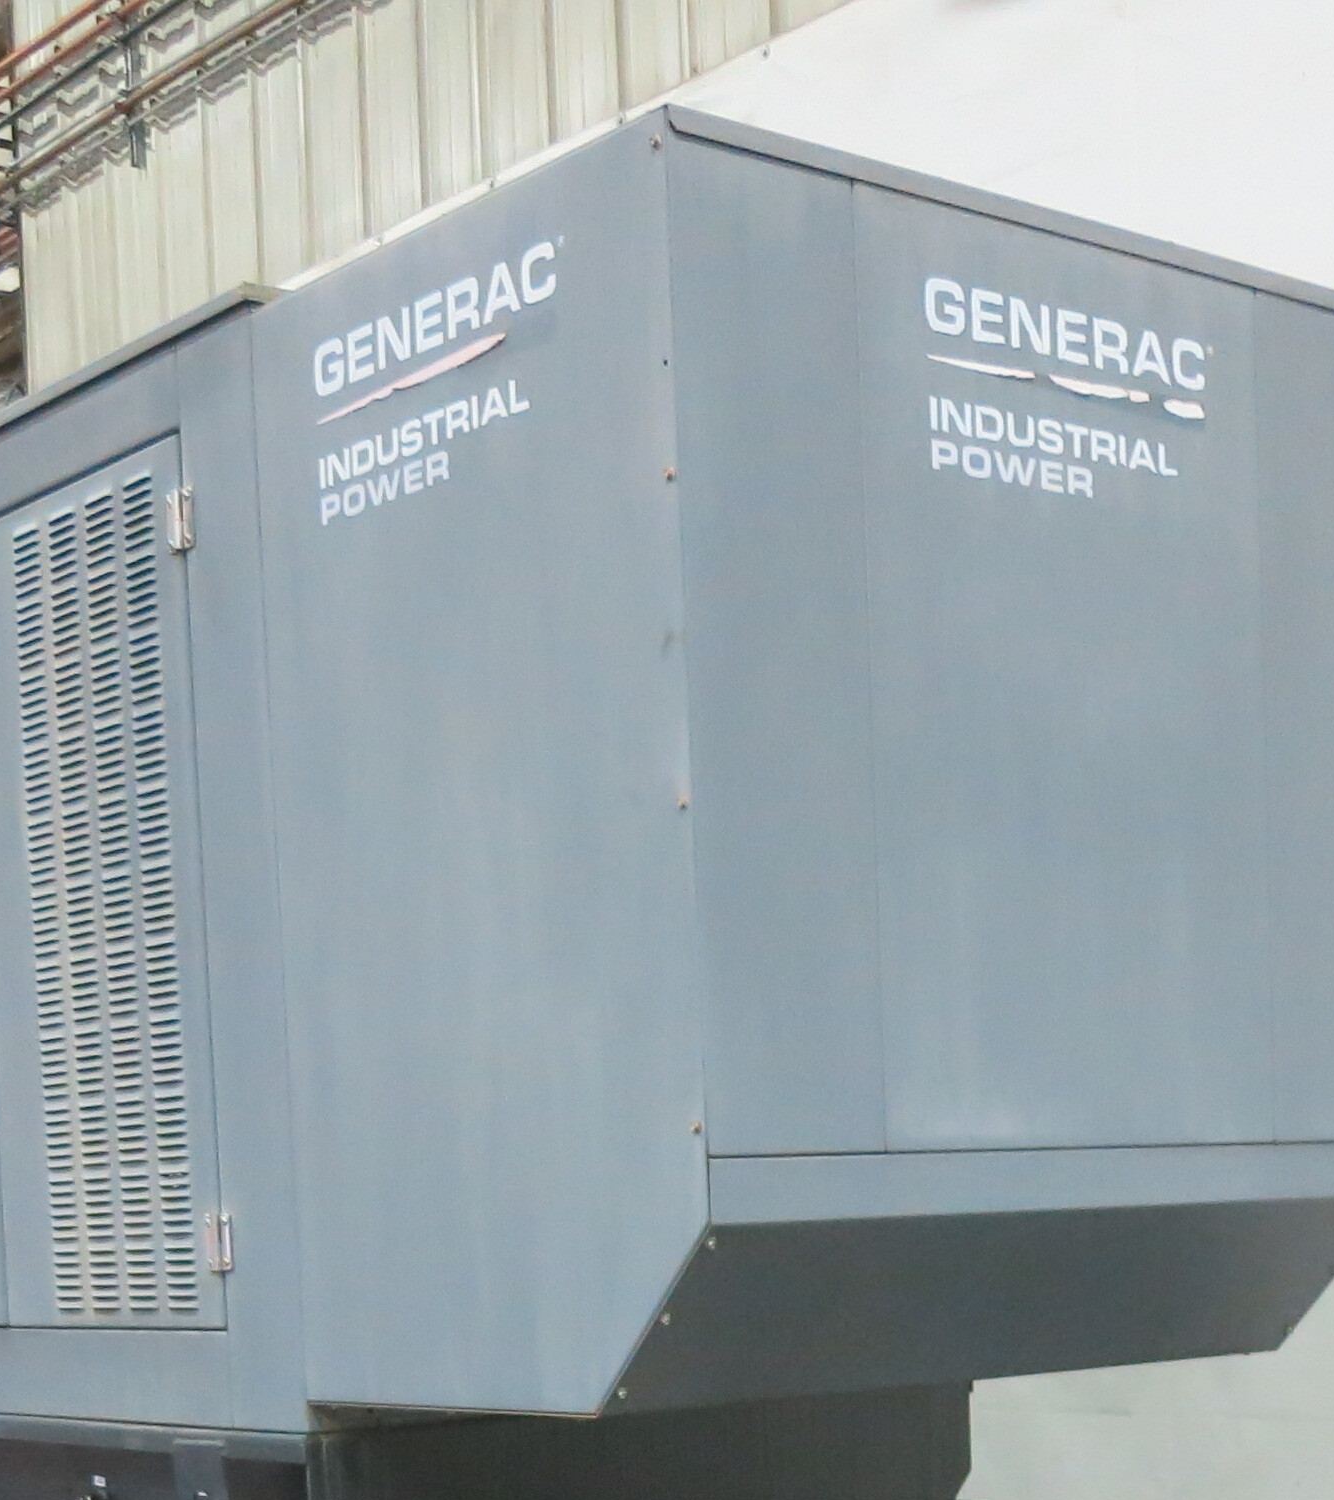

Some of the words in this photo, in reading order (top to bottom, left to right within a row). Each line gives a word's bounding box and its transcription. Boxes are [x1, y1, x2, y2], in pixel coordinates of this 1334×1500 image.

[313, 241, 557, 397] GENERAC
[924, 277, 1206, 391] GENERAC
[317, 378, 531, 489] INDUSTRIAL
[929, 395, 1179, 476] INDUSTRIAL
[930, 437, 1094, 498] POWER
[319, 450, 451, 526] POWER
